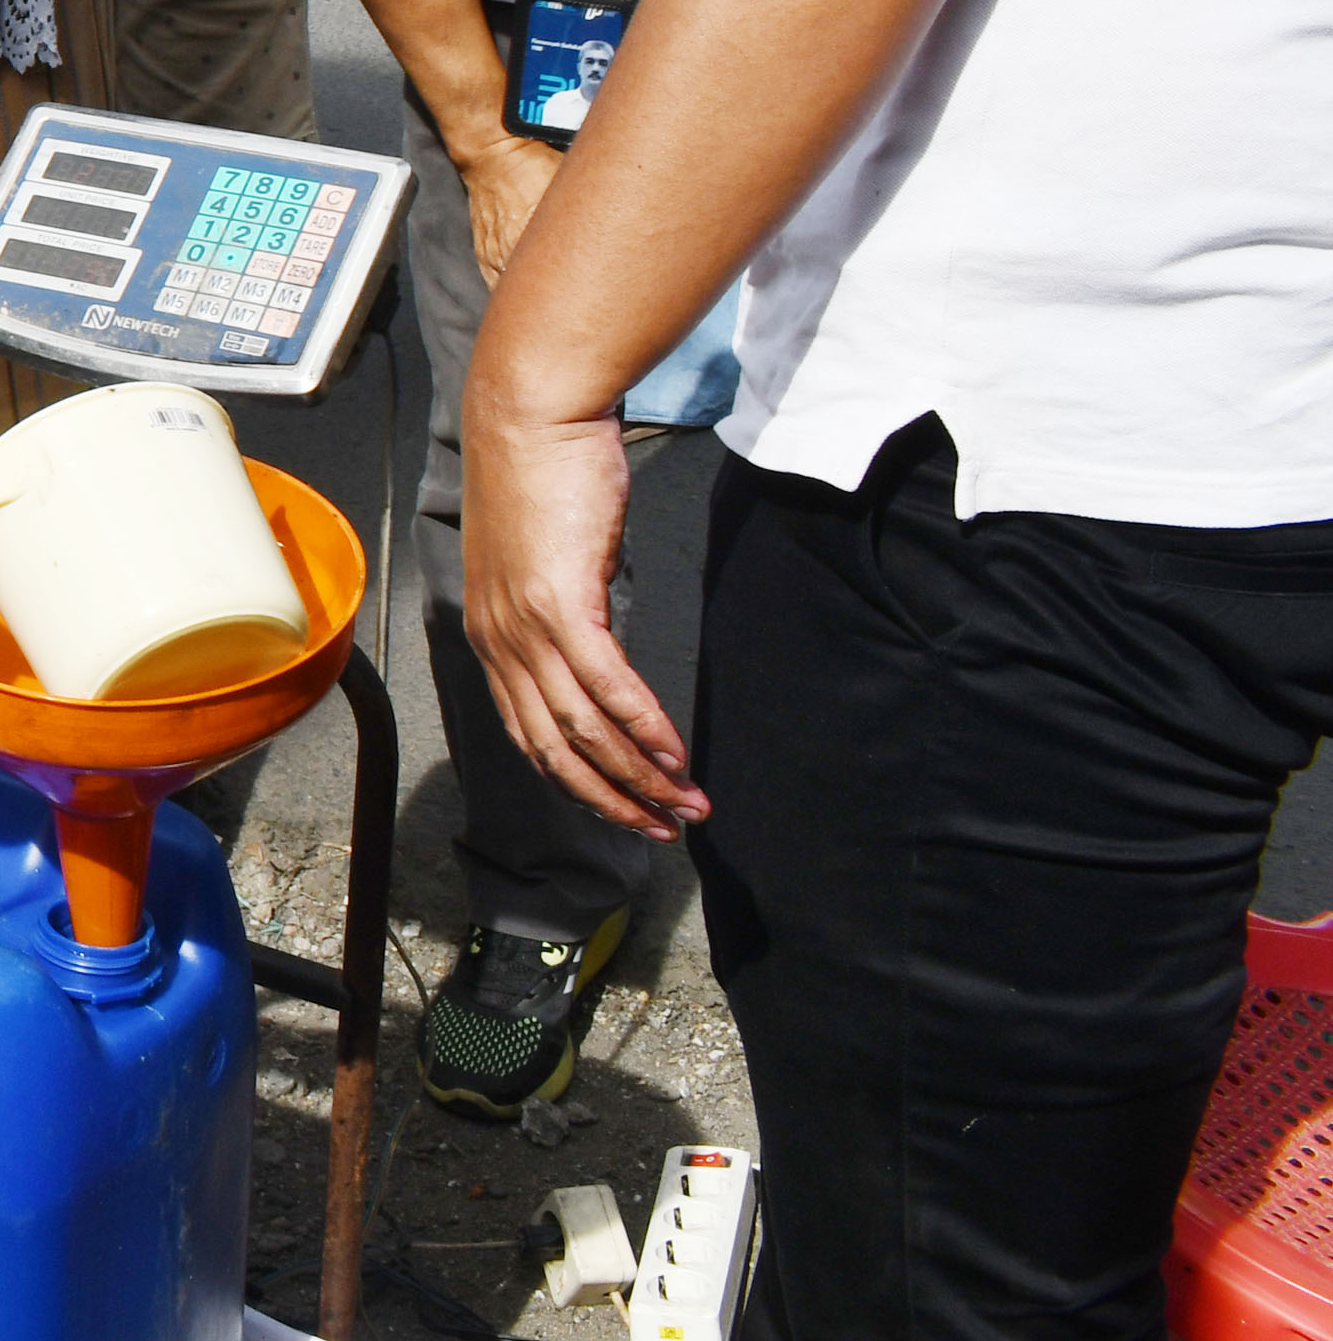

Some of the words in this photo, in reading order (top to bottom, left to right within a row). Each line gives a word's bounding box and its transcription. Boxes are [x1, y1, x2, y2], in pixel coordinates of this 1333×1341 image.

[224, 170, 240, 188] 7
[256, 177, 274, 195] 8
[290, 182, 309, 201] 9
[326, 190, 344, 206] C
[209, 196, 228, 214] 4
[244, 201, 263, 219] 5
[278, 207, 299, 225] 6
[311, 214, 337, 231] ADD
[37, 233, 68, 248] TOTAL
[71, 238, 103, 253] PRICE
[204, 220, 215, 238] 1
[232, 226, 251, 244] 2
[267, 232, 286, 250] 3
[301, 237, 328, 257] TARE
[187, 244, 205, 262] 0
[286, 264, 316, 281] ZERO
[172, 267, 196, 286] M1
[207, 273, 233, 292] M2
[241, 280, 267, 298] M3
[276, 287, 303, 305] M4
[161, 291, 185, 310] M5
[196, 298, 221, 317] M6
[230, 305, 256, 324] M7
[112, 315, 181, 339] NEWTECH
